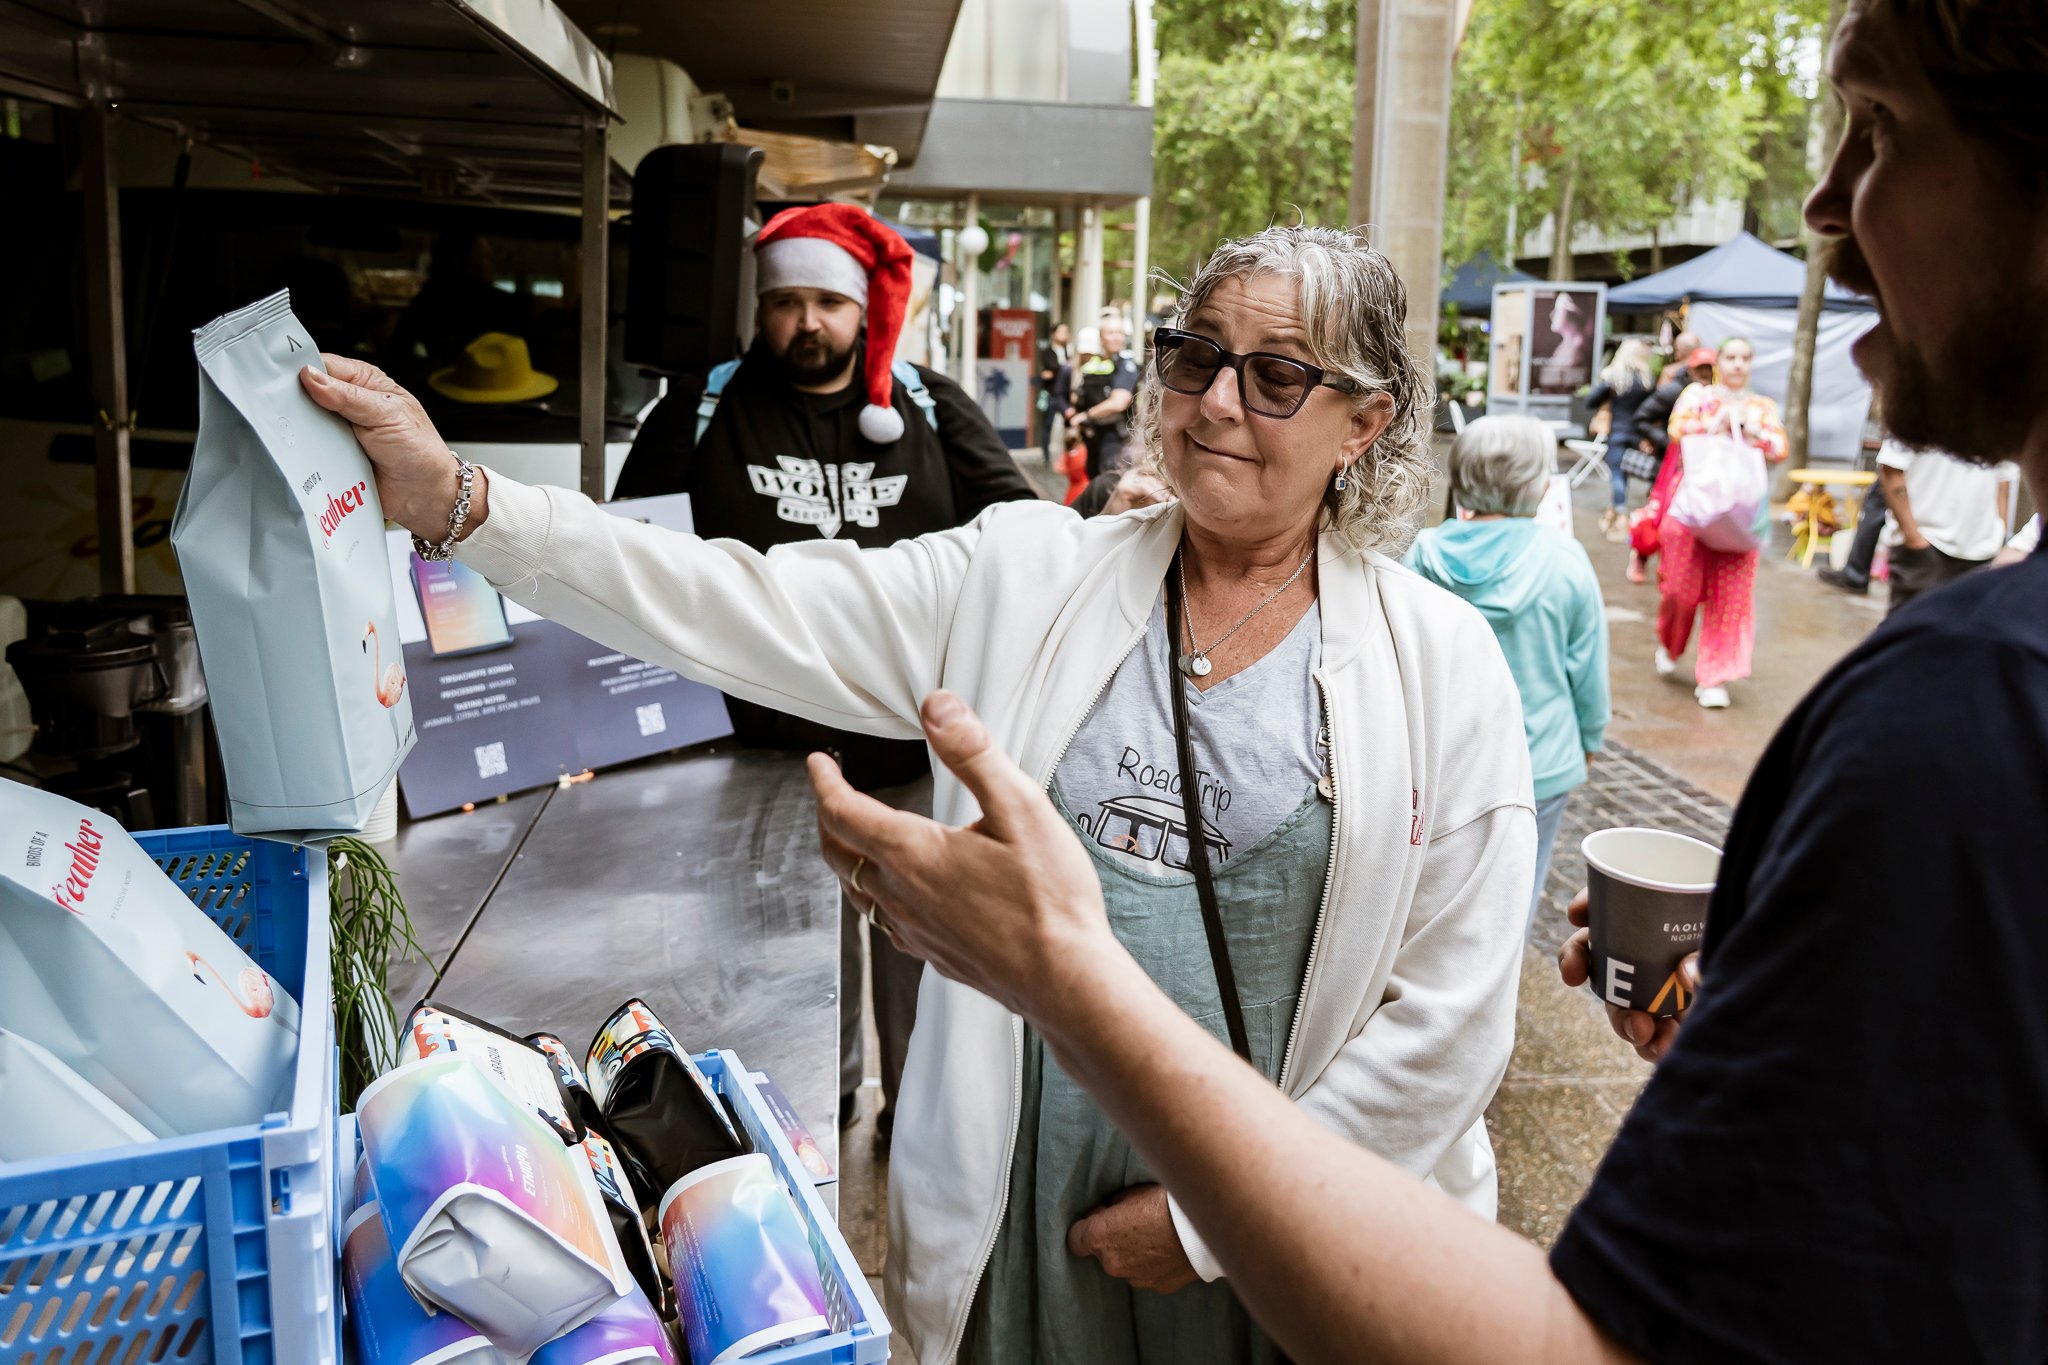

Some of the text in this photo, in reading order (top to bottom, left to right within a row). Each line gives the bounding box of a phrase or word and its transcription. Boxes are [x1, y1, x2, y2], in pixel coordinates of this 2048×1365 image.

[1194, 770, 1232, 822] Trip
[26, 845, 44, 867] BIRDS
[515, 1143, 536, 1198] ETHIOPIA
